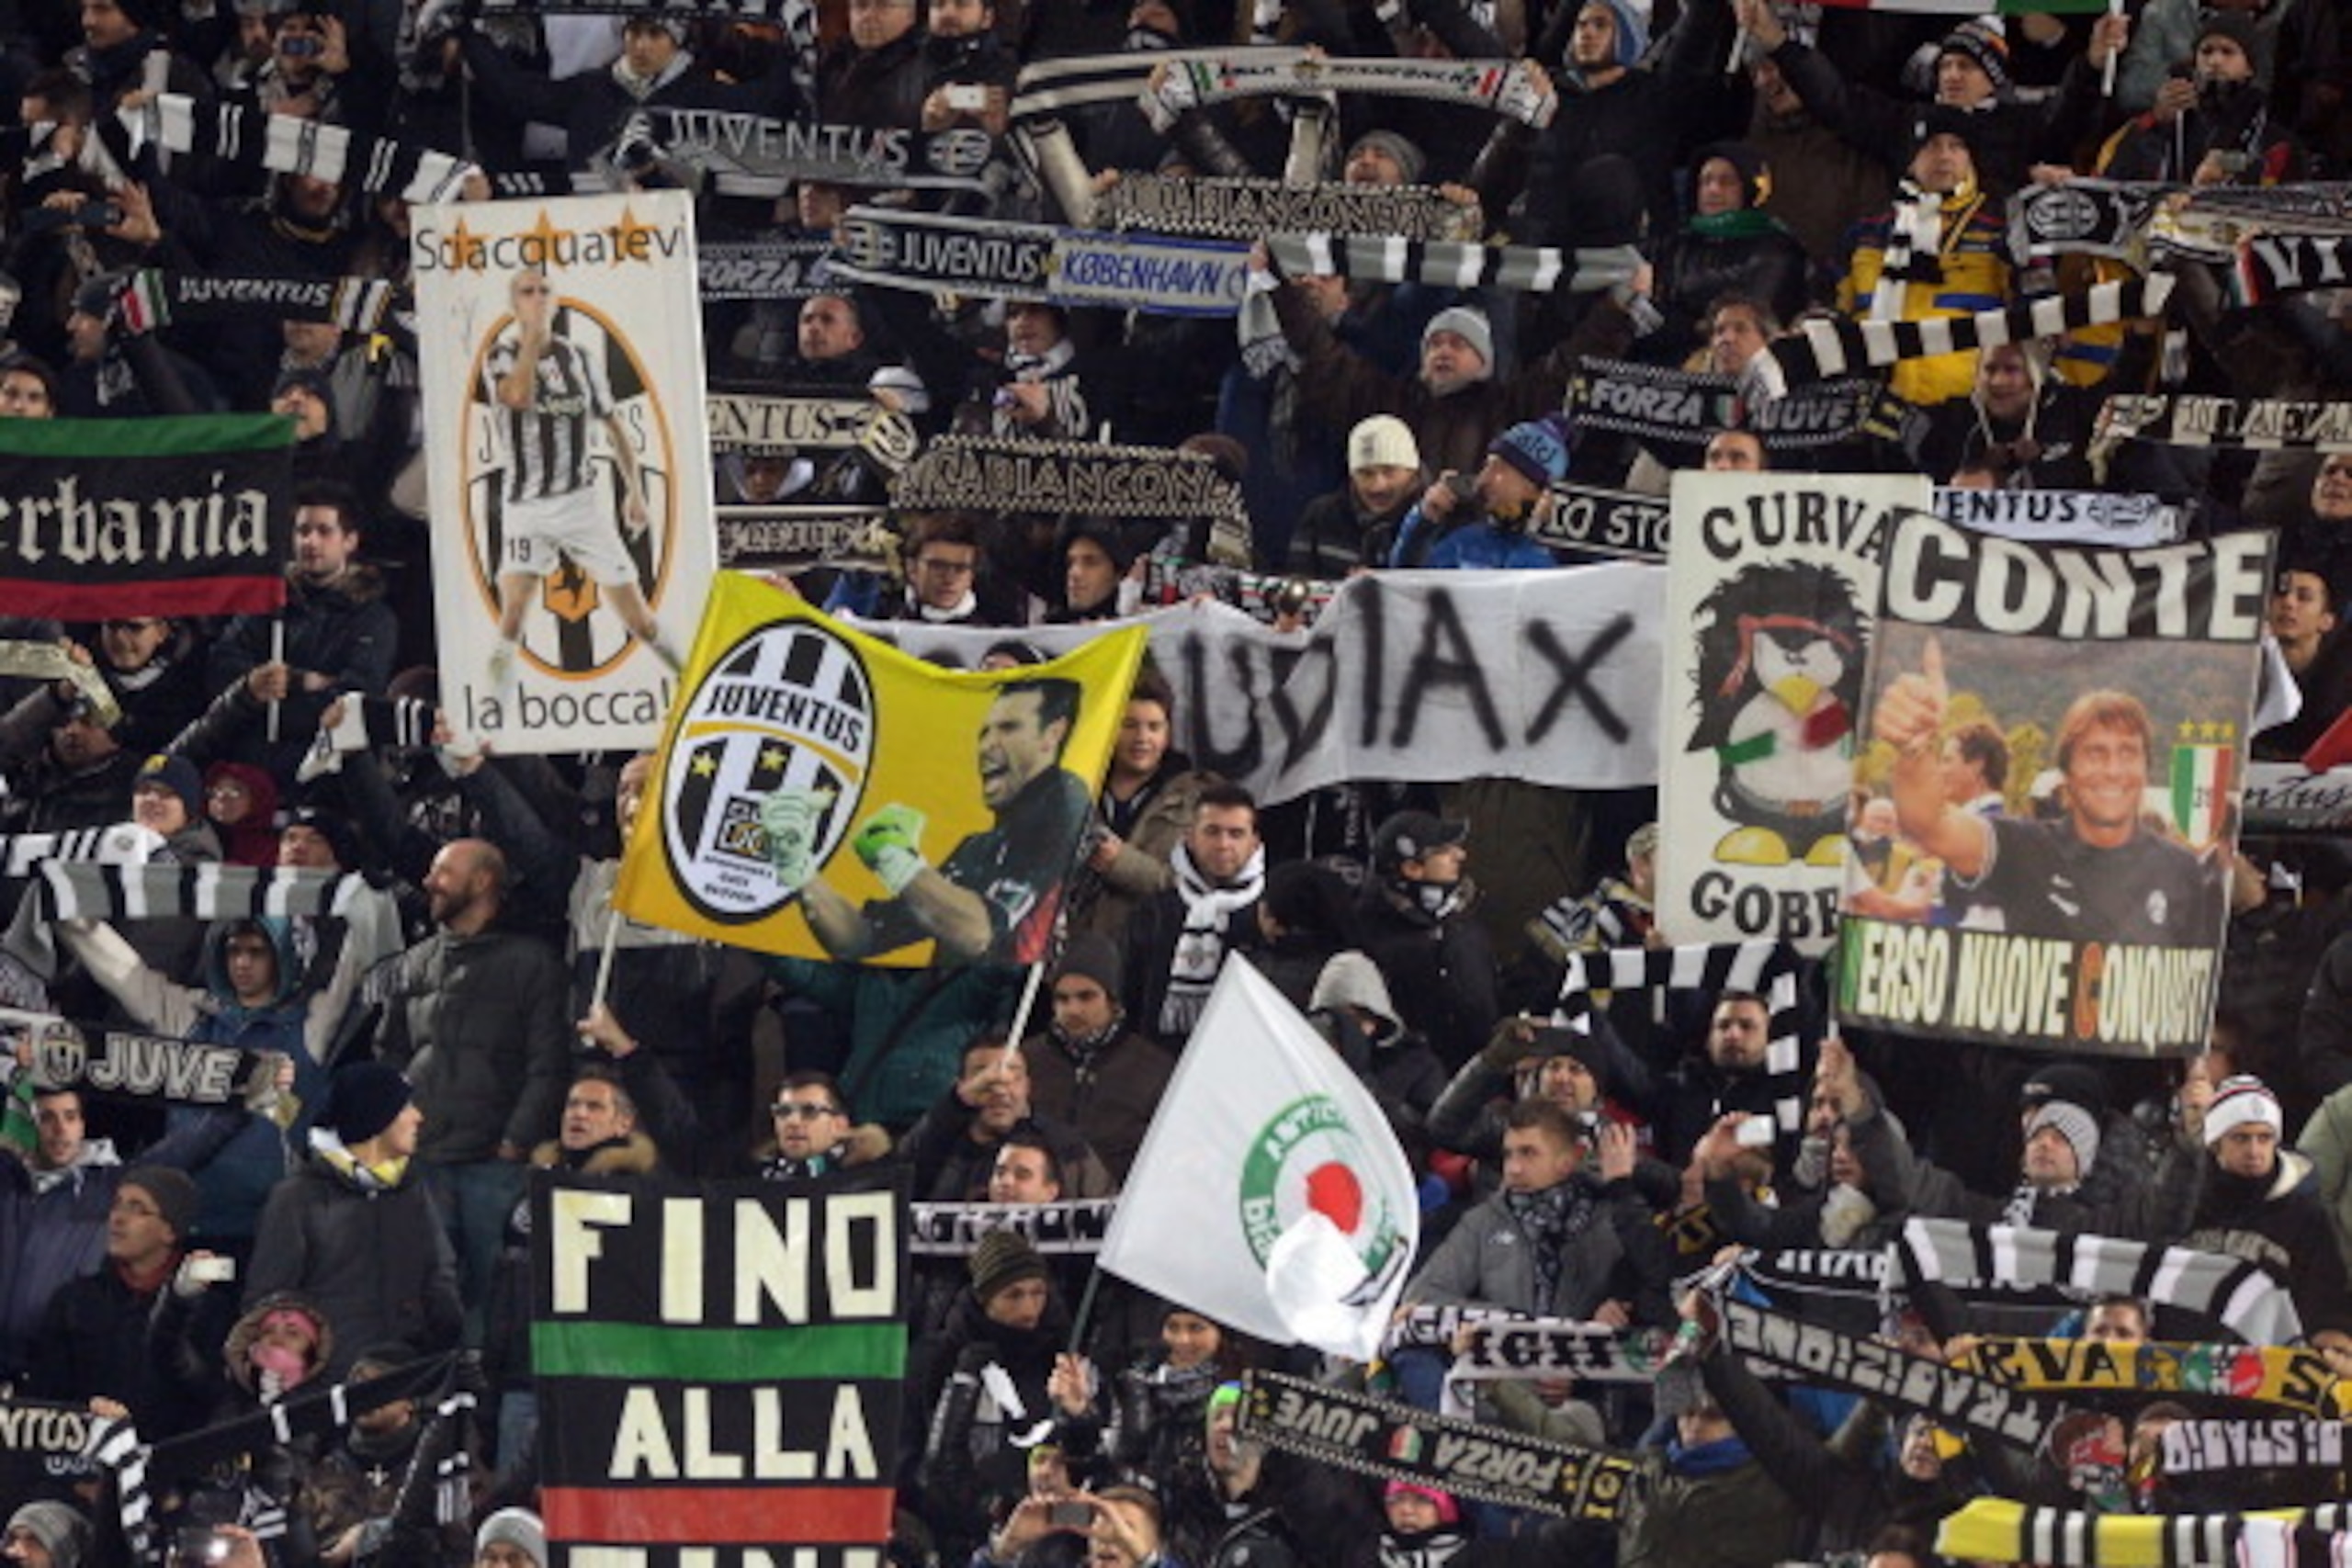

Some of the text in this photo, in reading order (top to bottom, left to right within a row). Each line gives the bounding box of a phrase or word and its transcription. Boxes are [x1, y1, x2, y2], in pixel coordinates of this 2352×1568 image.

[668, 108, 913, 170] JUVENTUS
[178, 276, 332, 307] JUVENTUS
[899, 232, 1223, 295] JUVENTUS KØBENHAVN
[1589, 378, 1704, 425] FORZA
[1702, 491, 1890, 562] CURVA
[1887, 518, 2268, 640] CONTE
[465, 677, 670, 729] la bocca!
[706, 684, 865, 752] JUVENTUS
[1840, 919, 1950, 1027] VERSO
[1953, 932, 2074, 1037] NUOVE
[86, 1022, 242, 1103] JUVE
[552, 1189, 896, 1325] FINO
[607, 1383, 878, 1480] ALLA
[1273, 1391, 1562, 1494] FORZA JUVE
